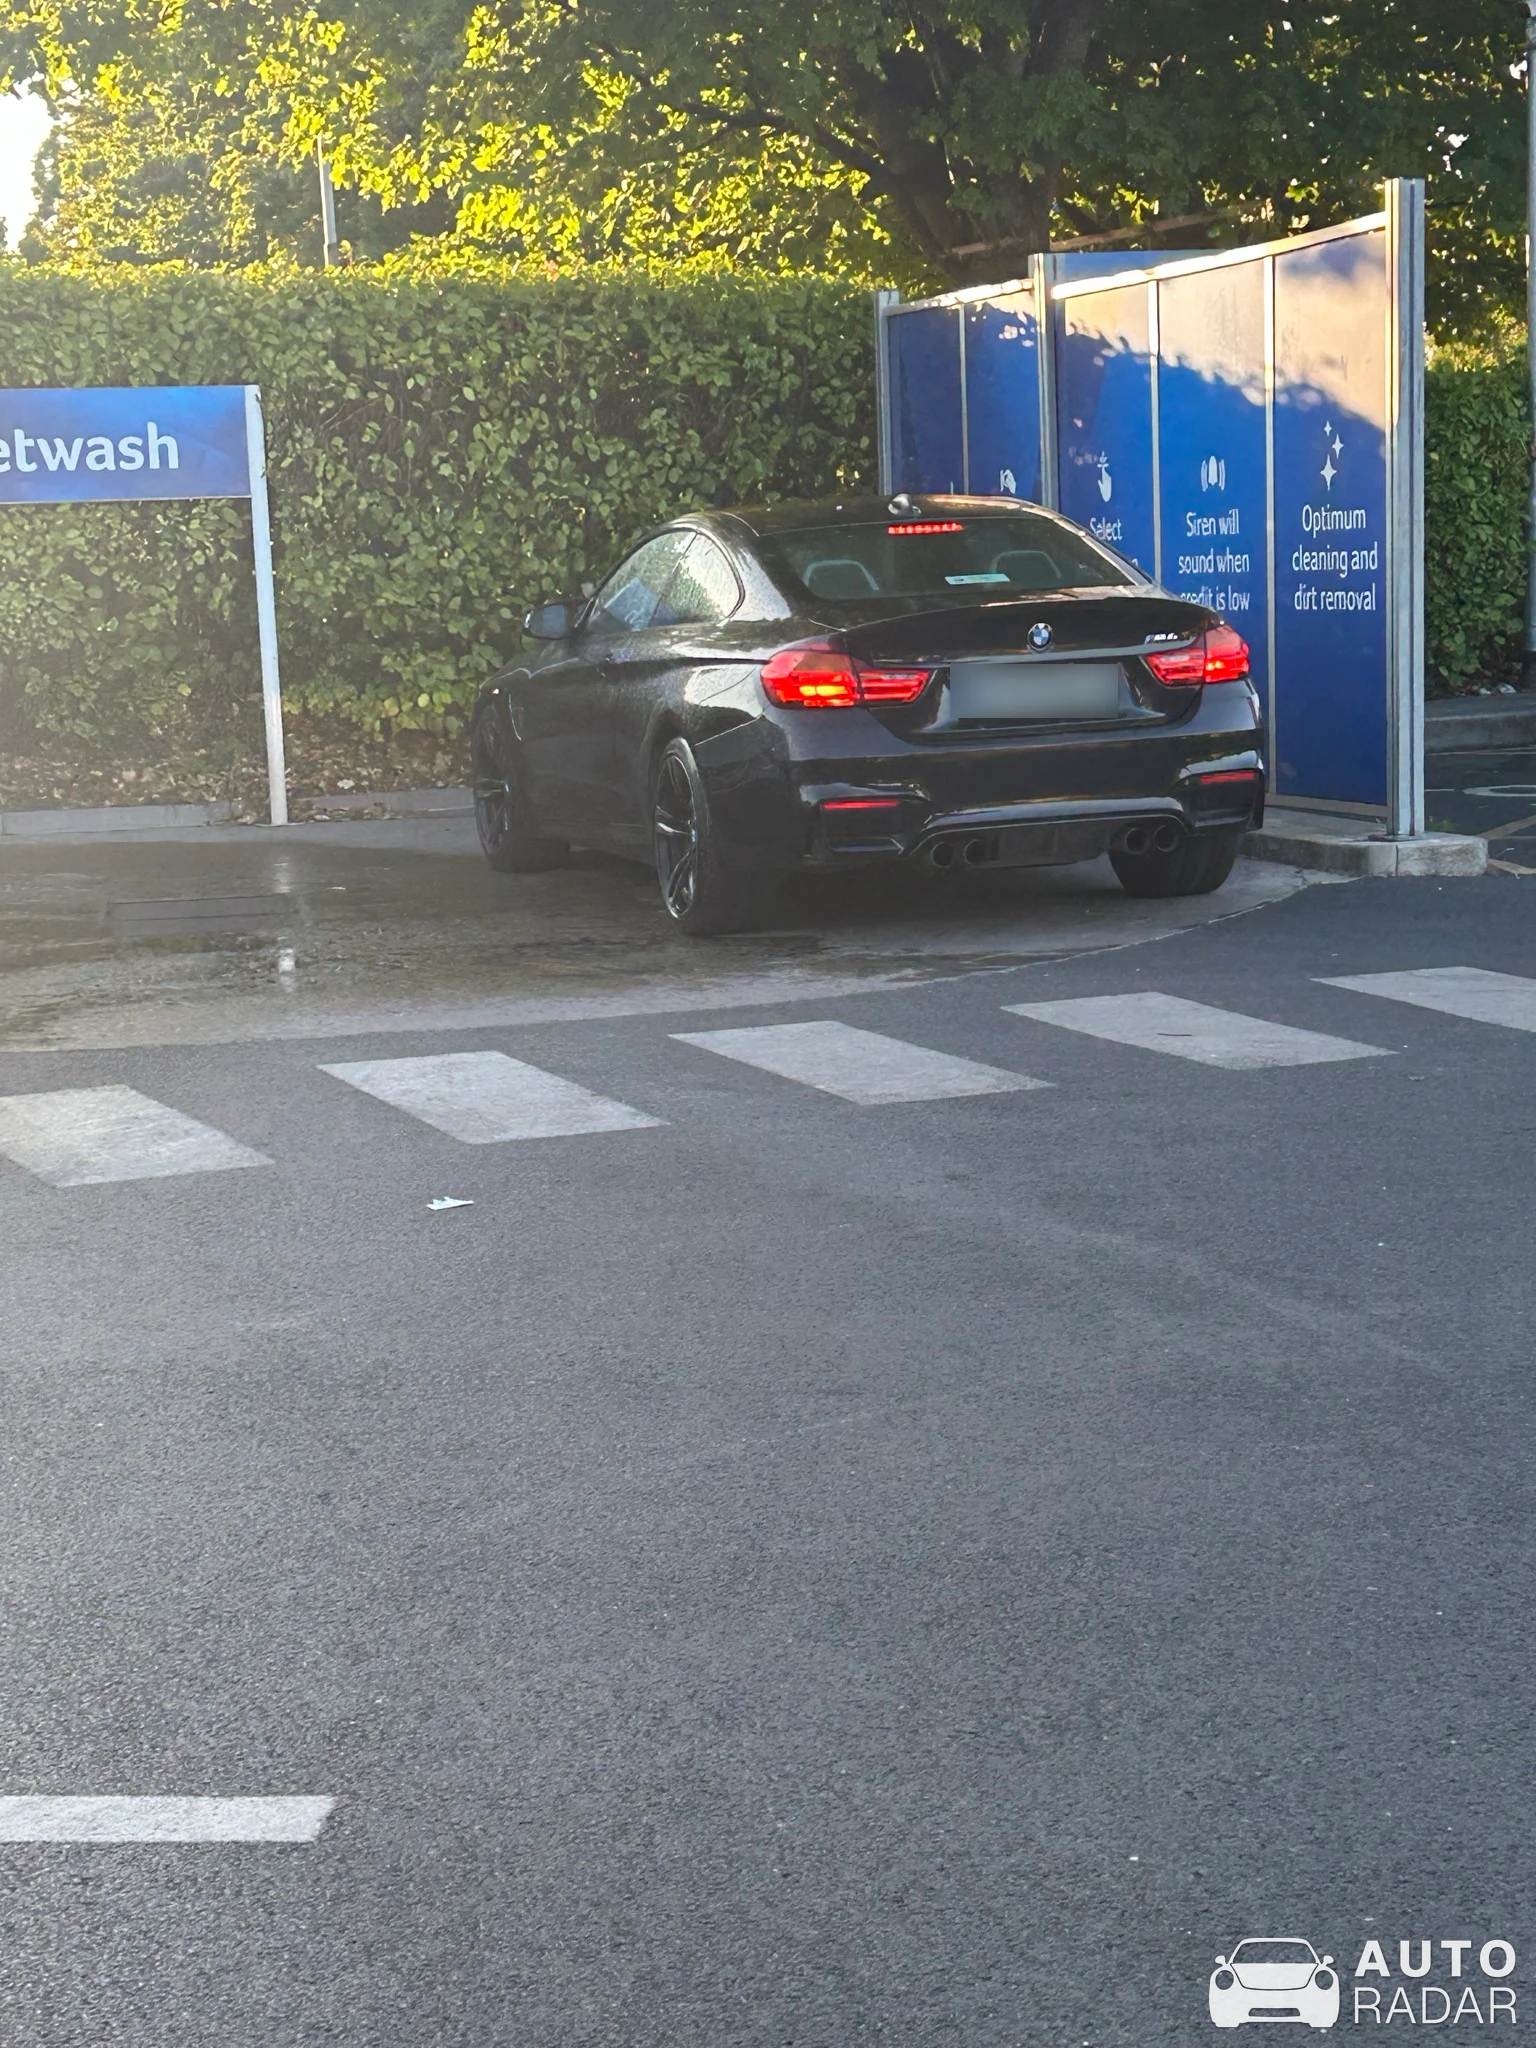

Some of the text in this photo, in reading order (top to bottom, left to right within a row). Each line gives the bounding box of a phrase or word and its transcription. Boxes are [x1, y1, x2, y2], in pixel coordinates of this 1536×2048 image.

[1089, 516, 1122, 541] Select
[1186, 508, 1240, 537] Siren will
[1302, 504, 1366, 538] Optimum
[1178, 546, 1250, 574] sound when
[1292, 541, 1378, 578] cleaning and
[1215, 585, 1226, 610] is
[1228, 584, 1251, 611] low
[1294, 582, 1376, 611] dirt removal
